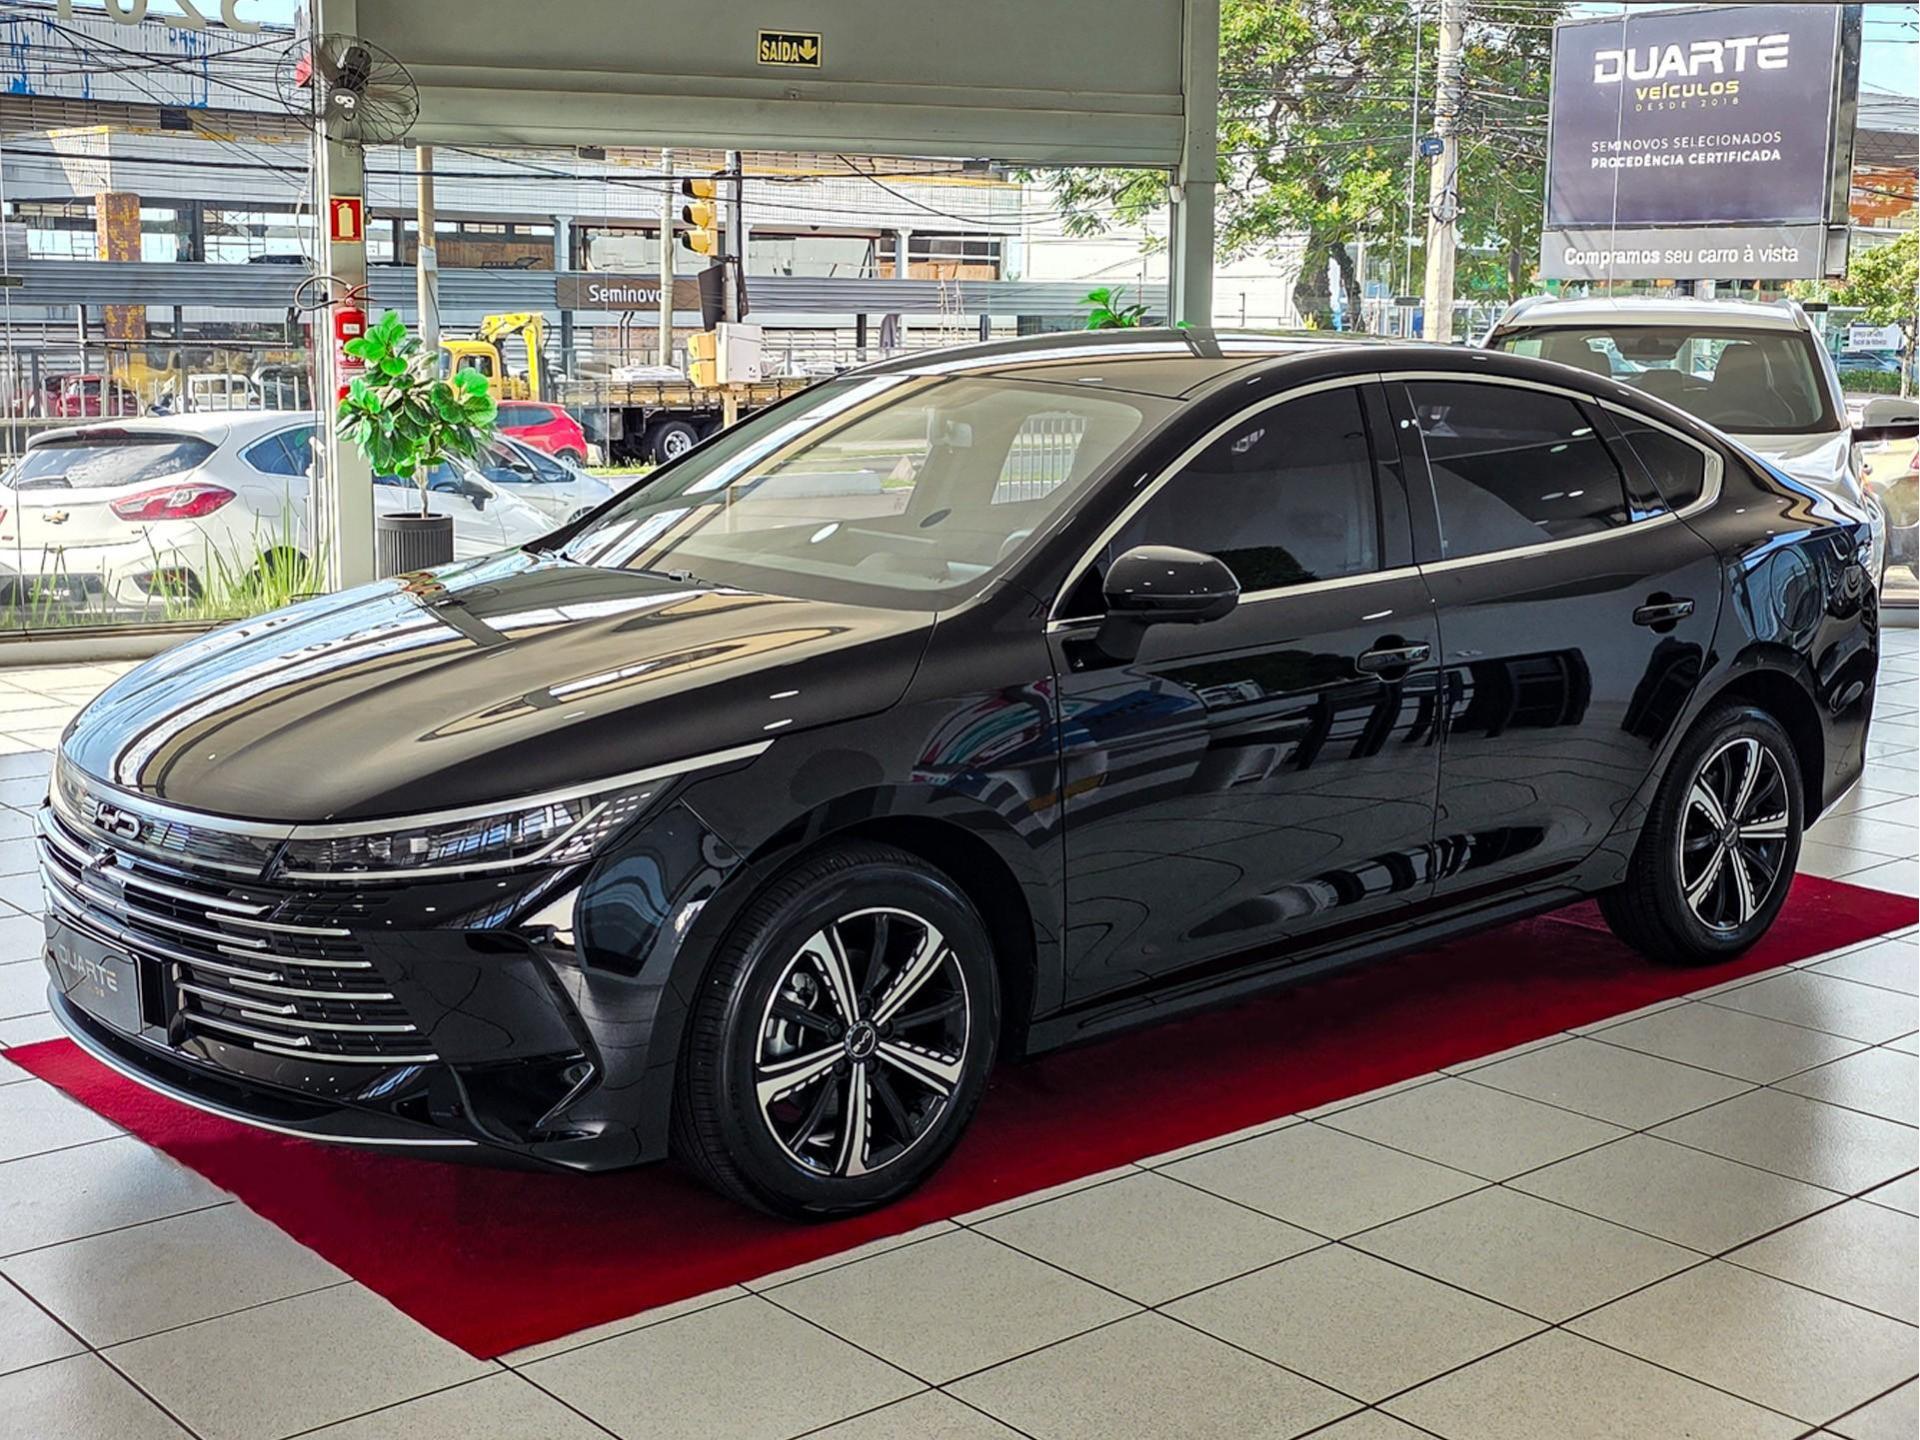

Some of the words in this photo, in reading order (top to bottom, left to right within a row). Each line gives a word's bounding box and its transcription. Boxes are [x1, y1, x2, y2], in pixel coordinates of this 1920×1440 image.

[761, 35, 800, 62] SAÍDA
[1593, 34, 1789, 83] DUARTE
[1636, 80, 1739, 100] VEÍCULOS
[1636, 101, 1687, 111] DESDE
[1591, 138, 1669, 153] SEMINOVOS
[1673, 131, 1782, 149] SELECIONADOS
[1591, 153, 1684, 168] PROCEDÊNCIA
[1688, 149, 1781, 164] CERTIFICADA
[1564, 247, 1660, 269] Compramos
[1664, 249, 1692, 264] seu
[1698, 247, 1738, 263] carro
[1743, 244, 1754, 262] à
[1759, 244, 1799, 262] vista
